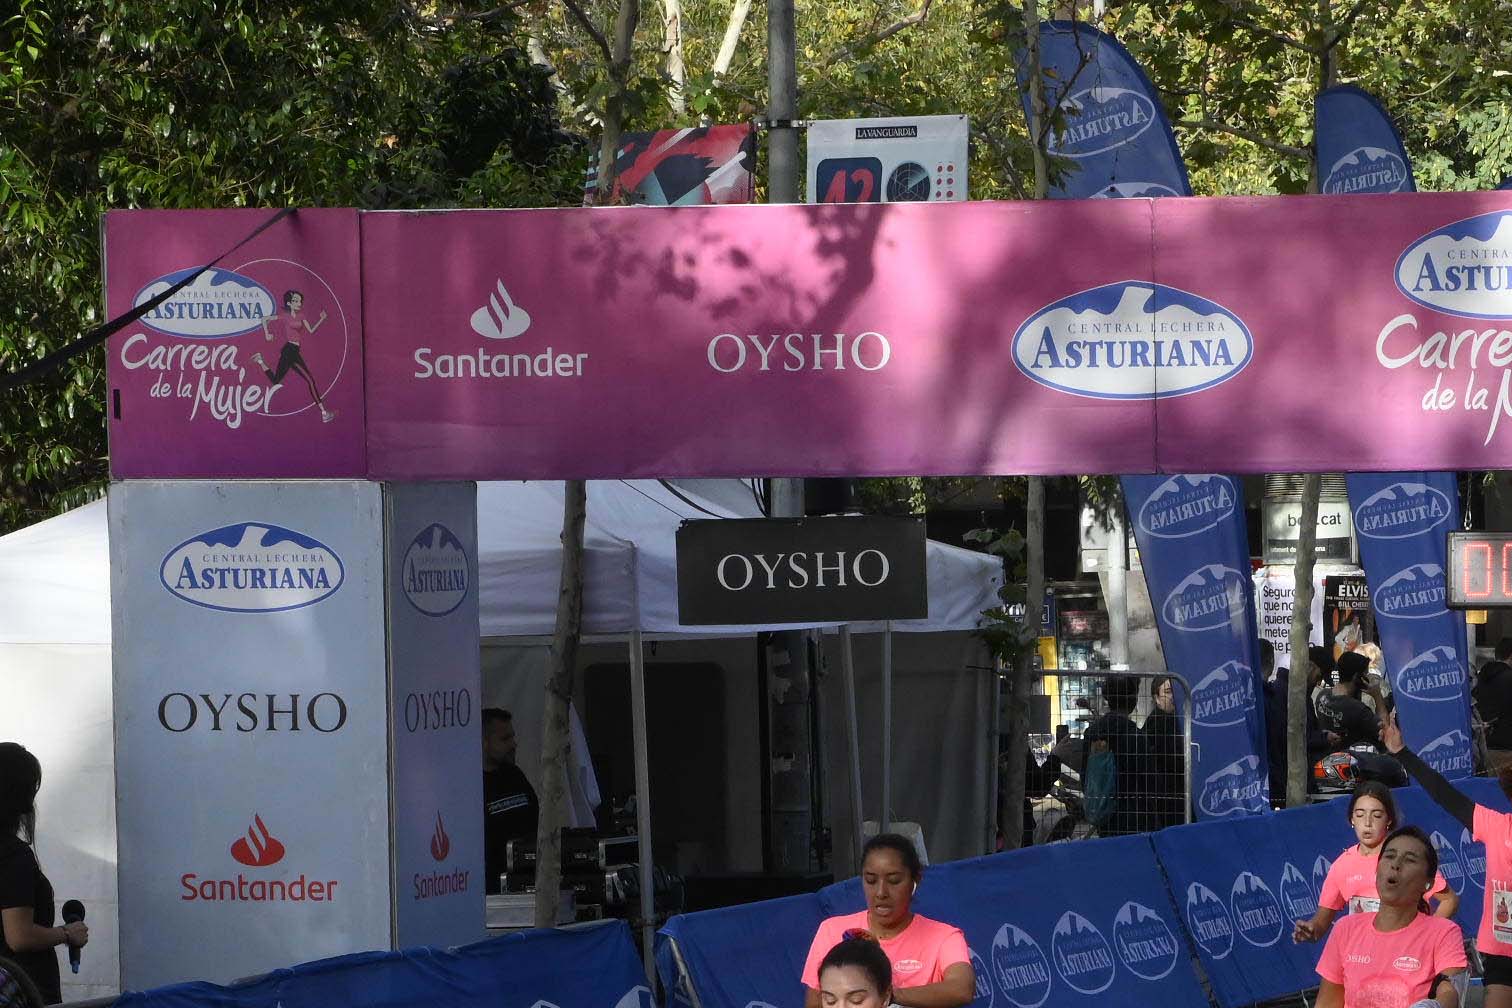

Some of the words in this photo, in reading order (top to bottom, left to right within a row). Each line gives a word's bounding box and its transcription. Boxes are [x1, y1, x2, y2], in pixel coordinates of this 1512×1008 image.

[867, 127, 916, 138] VANGUARDIA
[143, 293, 264, 320] ASTURIANA
[1067, 322, 1144, 333] CENTRAL
[1150, 321, 1226, 333] LECHERA
[121, 333, 239, 370] Carrera
[414, 347, 588, 378] Santander
[707, 332, 891, 373] OYSHO
[1031, 325, 1234, 370] ASTURIANA
[150, 373, 172, 398] de
[177, 372, 192, 397] la
[190, 367, 284, 429] Mujer
[1421, 372, 1456, 410] de
[1464, 370, 1488, 410] la
[174, 556, 331, 592] ASTURIANA
[202, 554, 261, 564] CENTRAL
[266, 553, 324, 563] LECHERA
[407, 556, 465, 594] ASTURIANA
[716, 549, 890, 591] OYSHO
[1264, 604, 1280, 613] que
[1338, 585, 1369, 598] ELVIS
[157, 692, 347, 733] OYSHO
[405, 687, 471, 733] OYSHO
[180, 874, 338, 902] Santander
[413, 867, 470, 900] Santander
[1058, 945, 1112, 976] ASTURIANA
